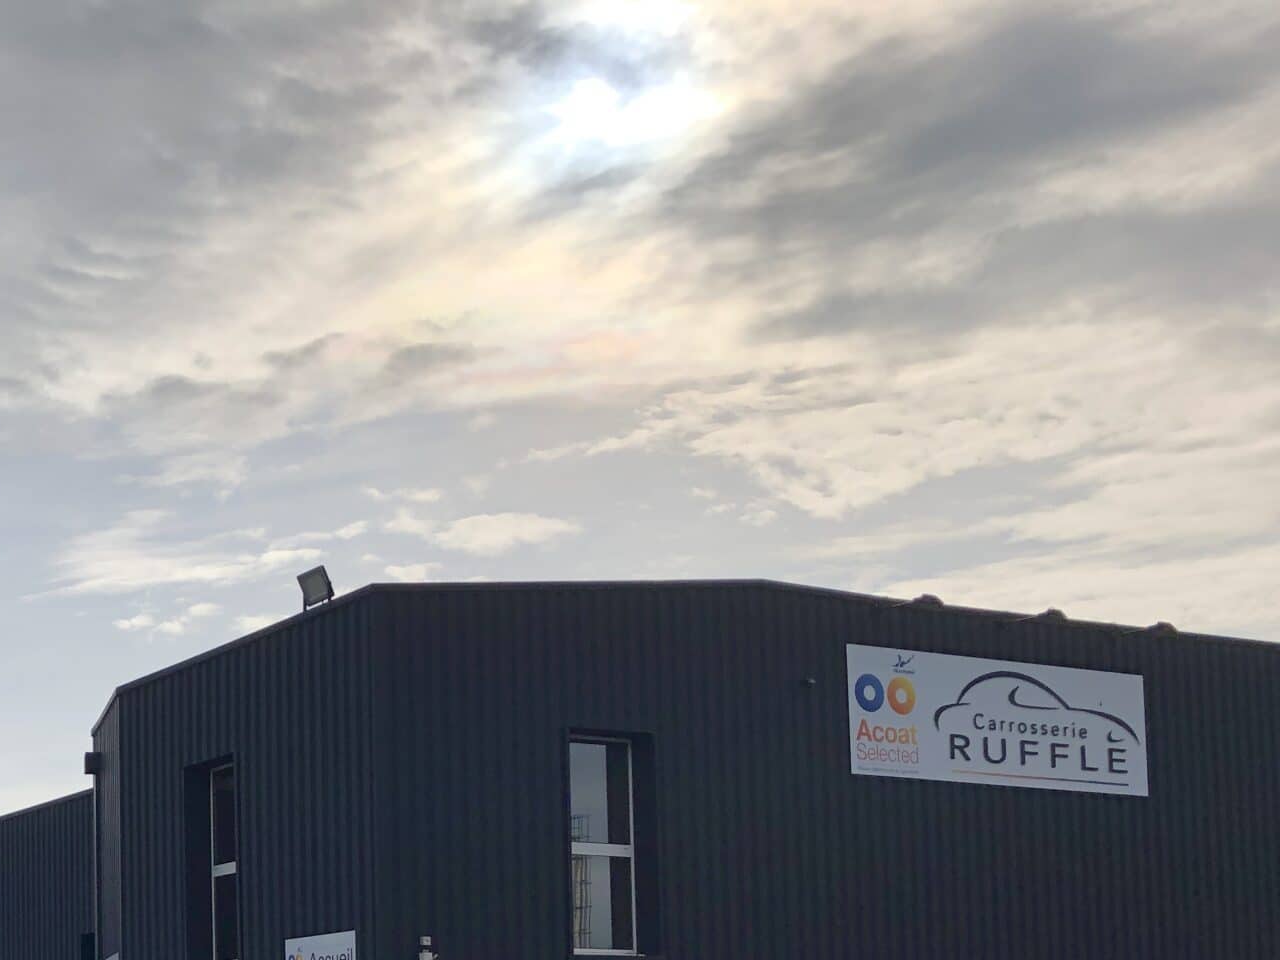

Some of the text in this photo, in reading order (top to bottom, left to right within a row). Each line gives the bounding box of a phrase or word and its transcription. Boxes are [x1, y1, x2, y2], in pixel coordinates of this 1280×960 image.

[856, 718, 918, 746] Acoat
[972, 712, 1089, 740] Carrosserie
[856, 742, 920, 765] Selected
[949, 733, 1129, 775] RUFFLE
